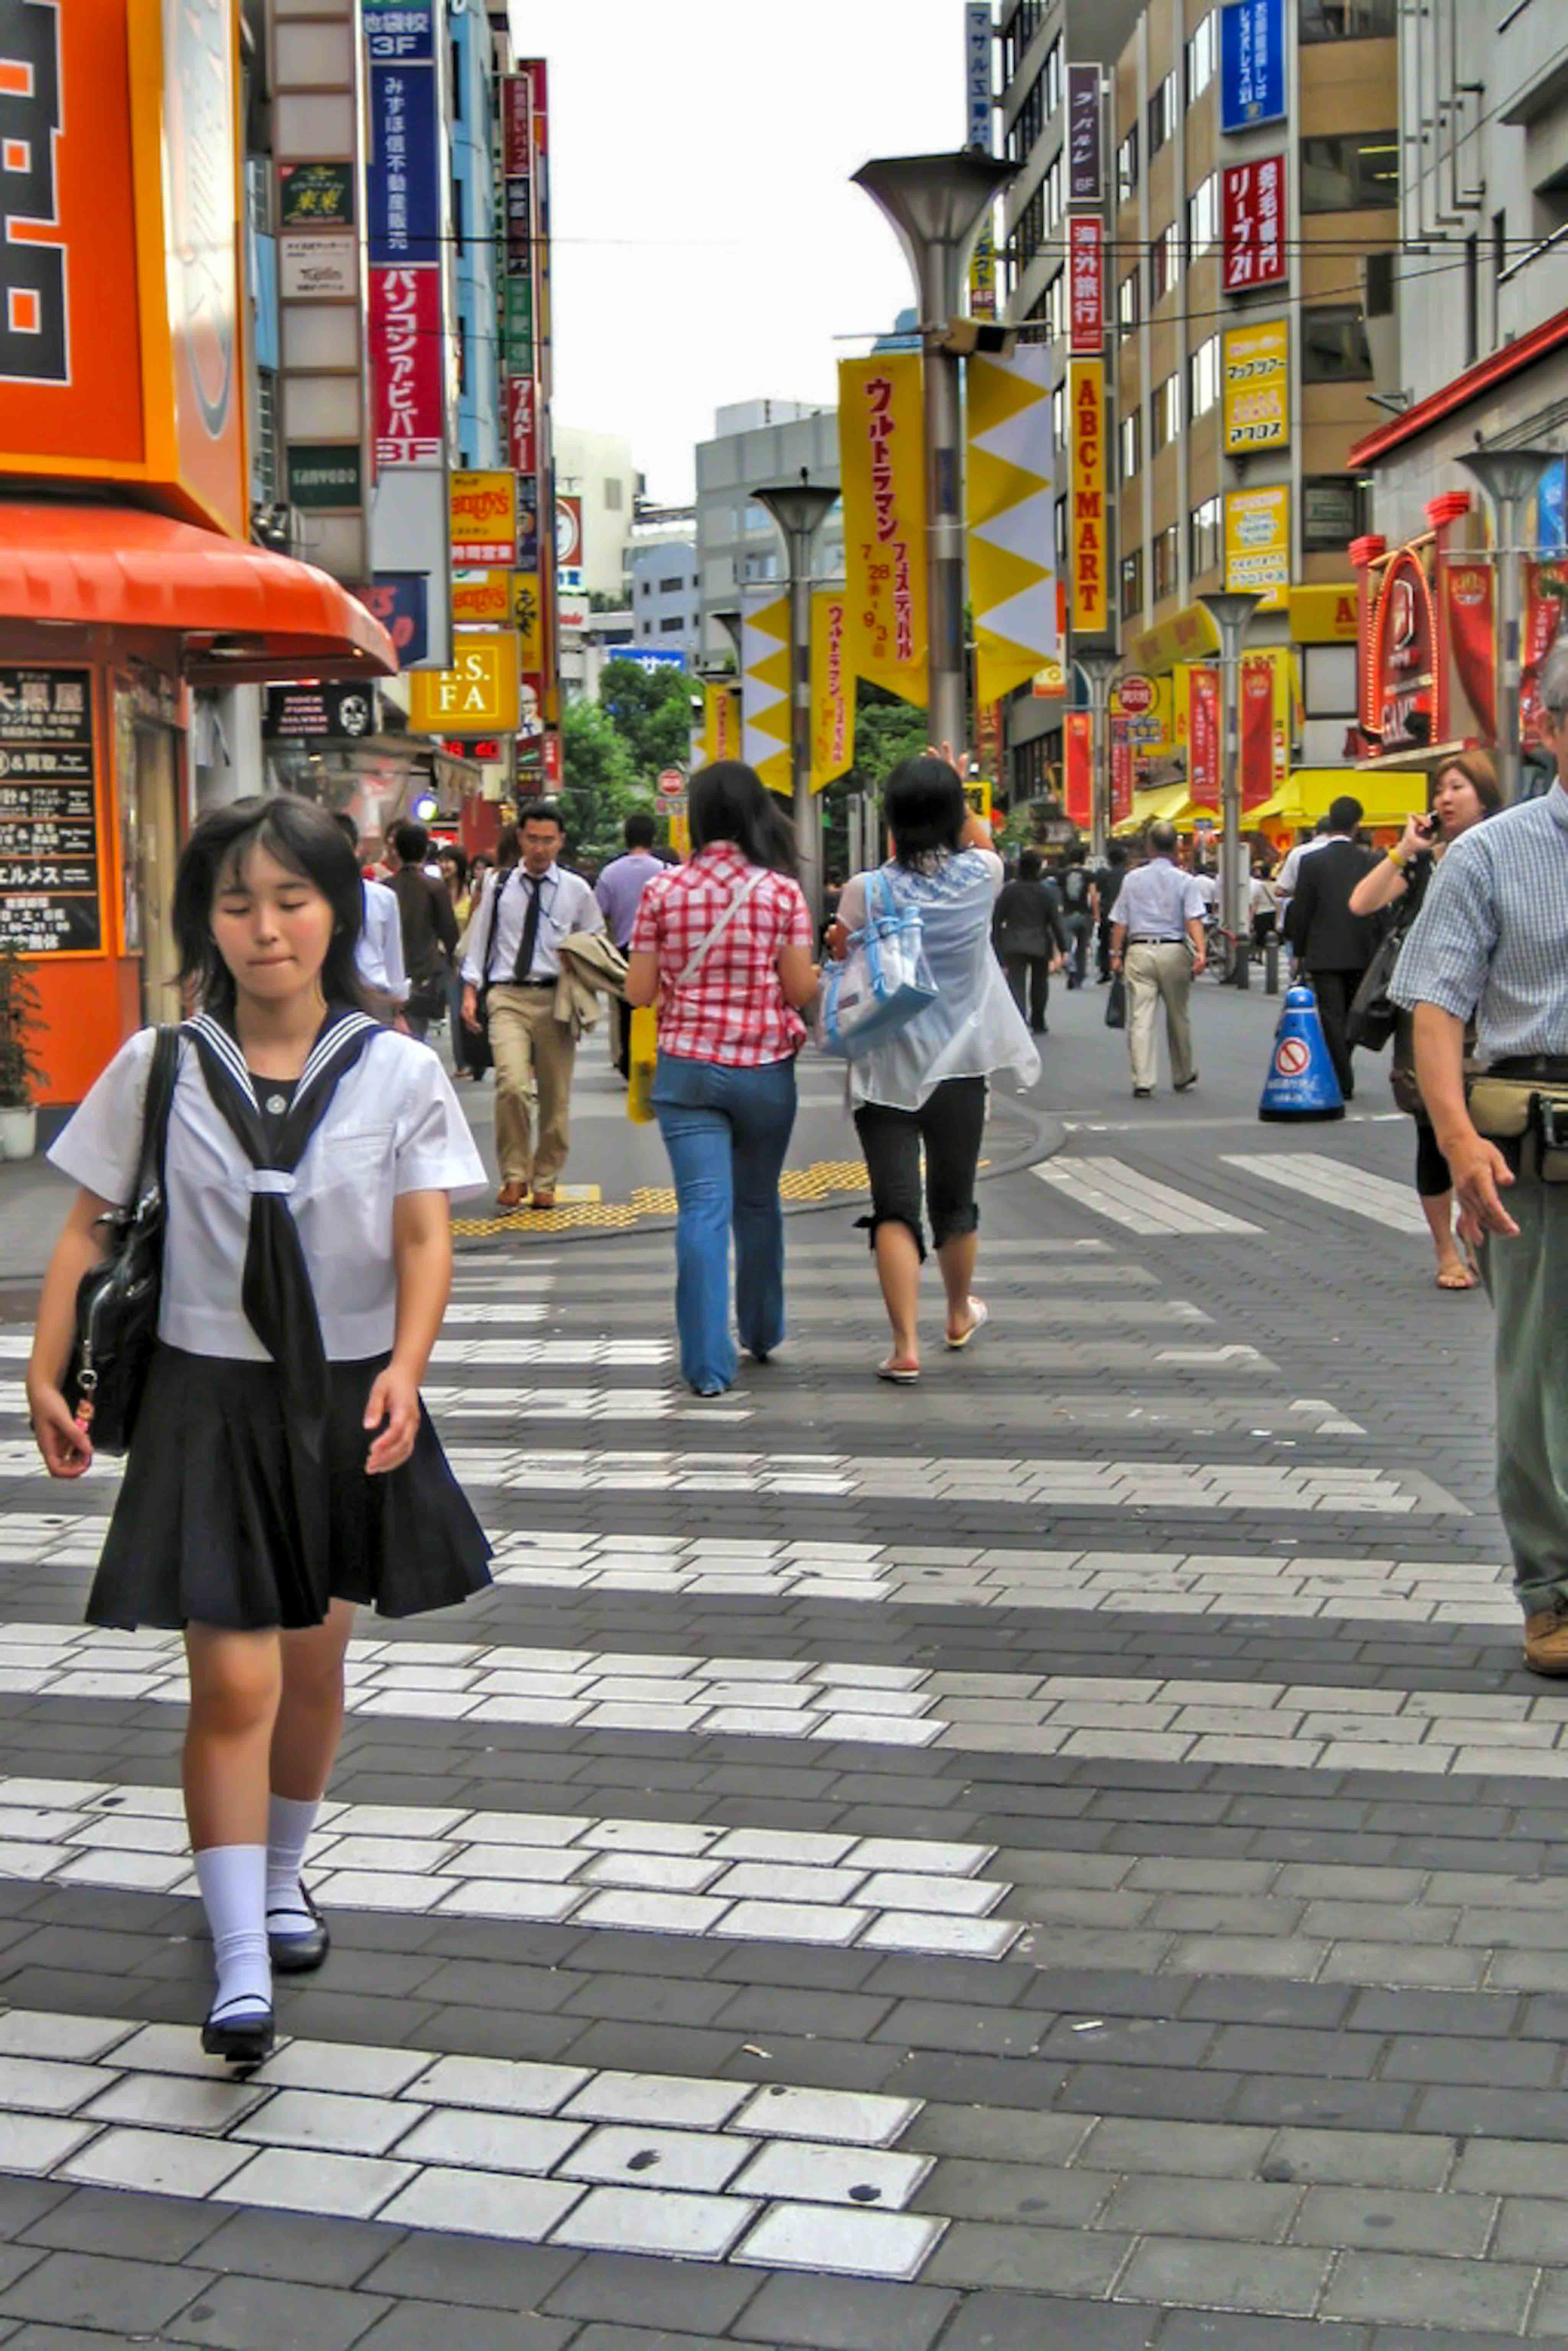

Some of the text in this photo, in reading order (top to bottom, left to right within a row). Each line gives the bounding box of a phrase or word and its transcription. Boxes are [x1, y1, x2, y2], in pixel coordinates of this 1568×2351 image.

[372, 36, 417, 55] 3F
[1074, 225, 1098, 323] 海外旅行
[383, 270, 418, 436] パソコンアビバ
[865, 378, 899, 541] ウルトラマン
